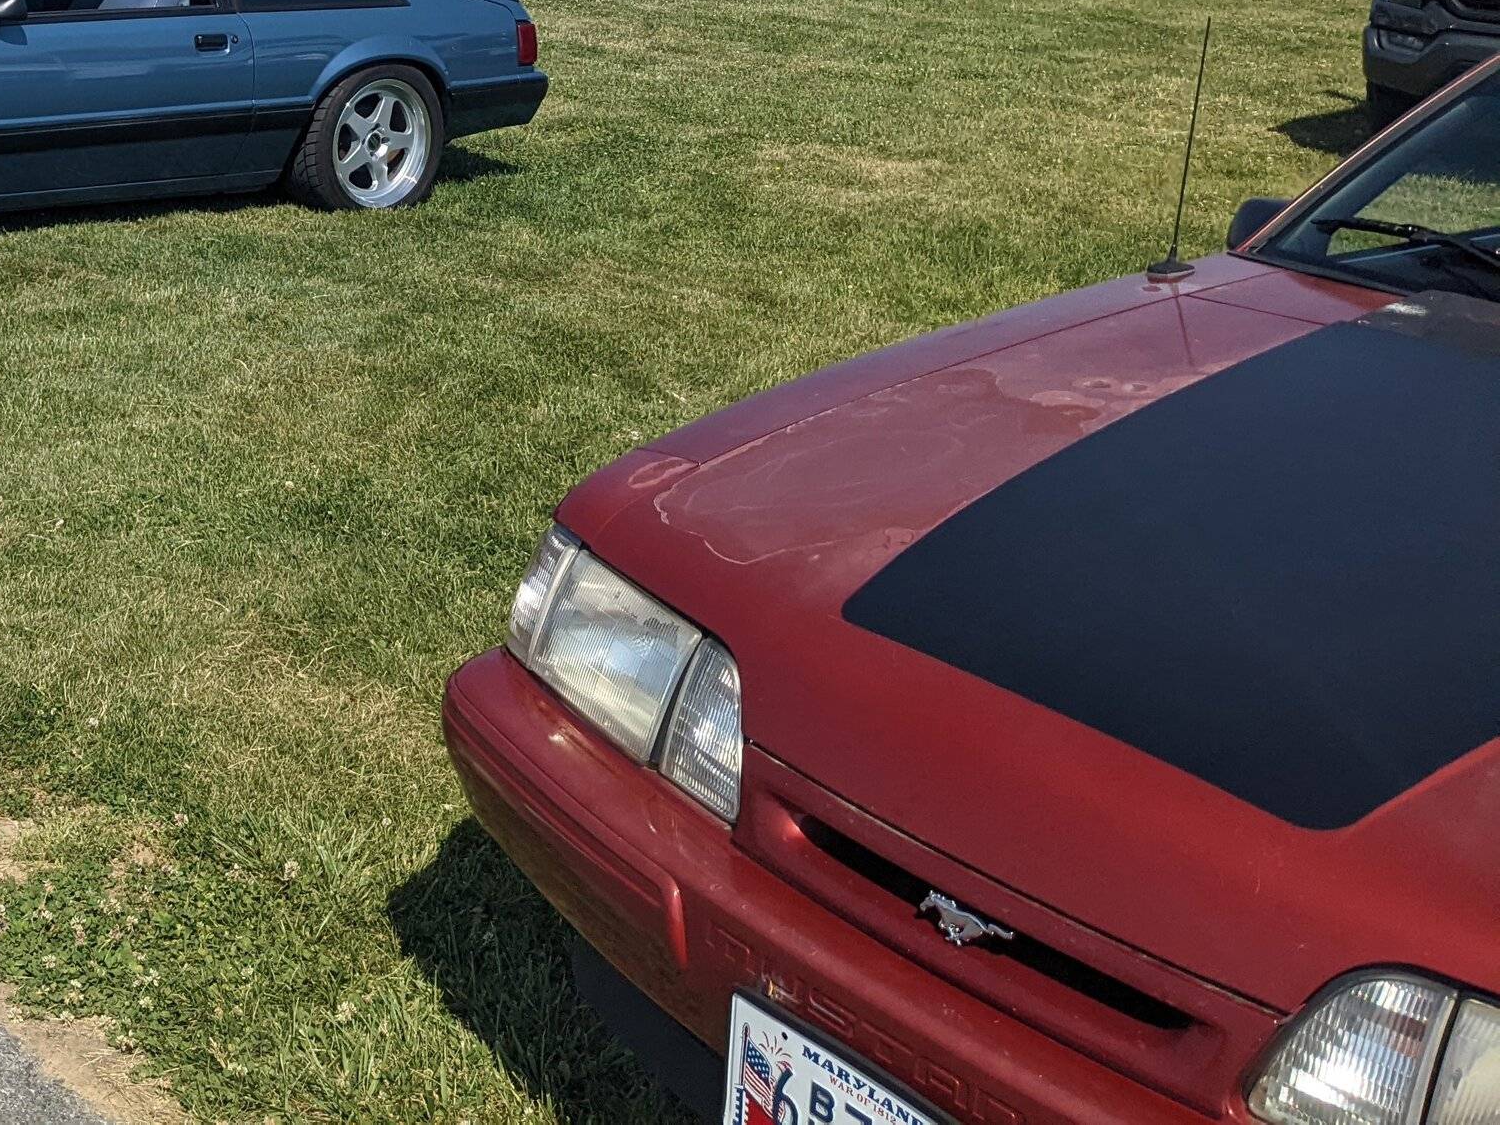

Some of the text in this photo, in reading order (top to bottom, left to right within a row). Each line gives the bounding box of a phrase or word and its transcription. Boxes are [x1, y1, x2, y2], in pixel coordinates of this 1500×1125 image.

[829, 1075, 897, 1125] WAR OF 1812
